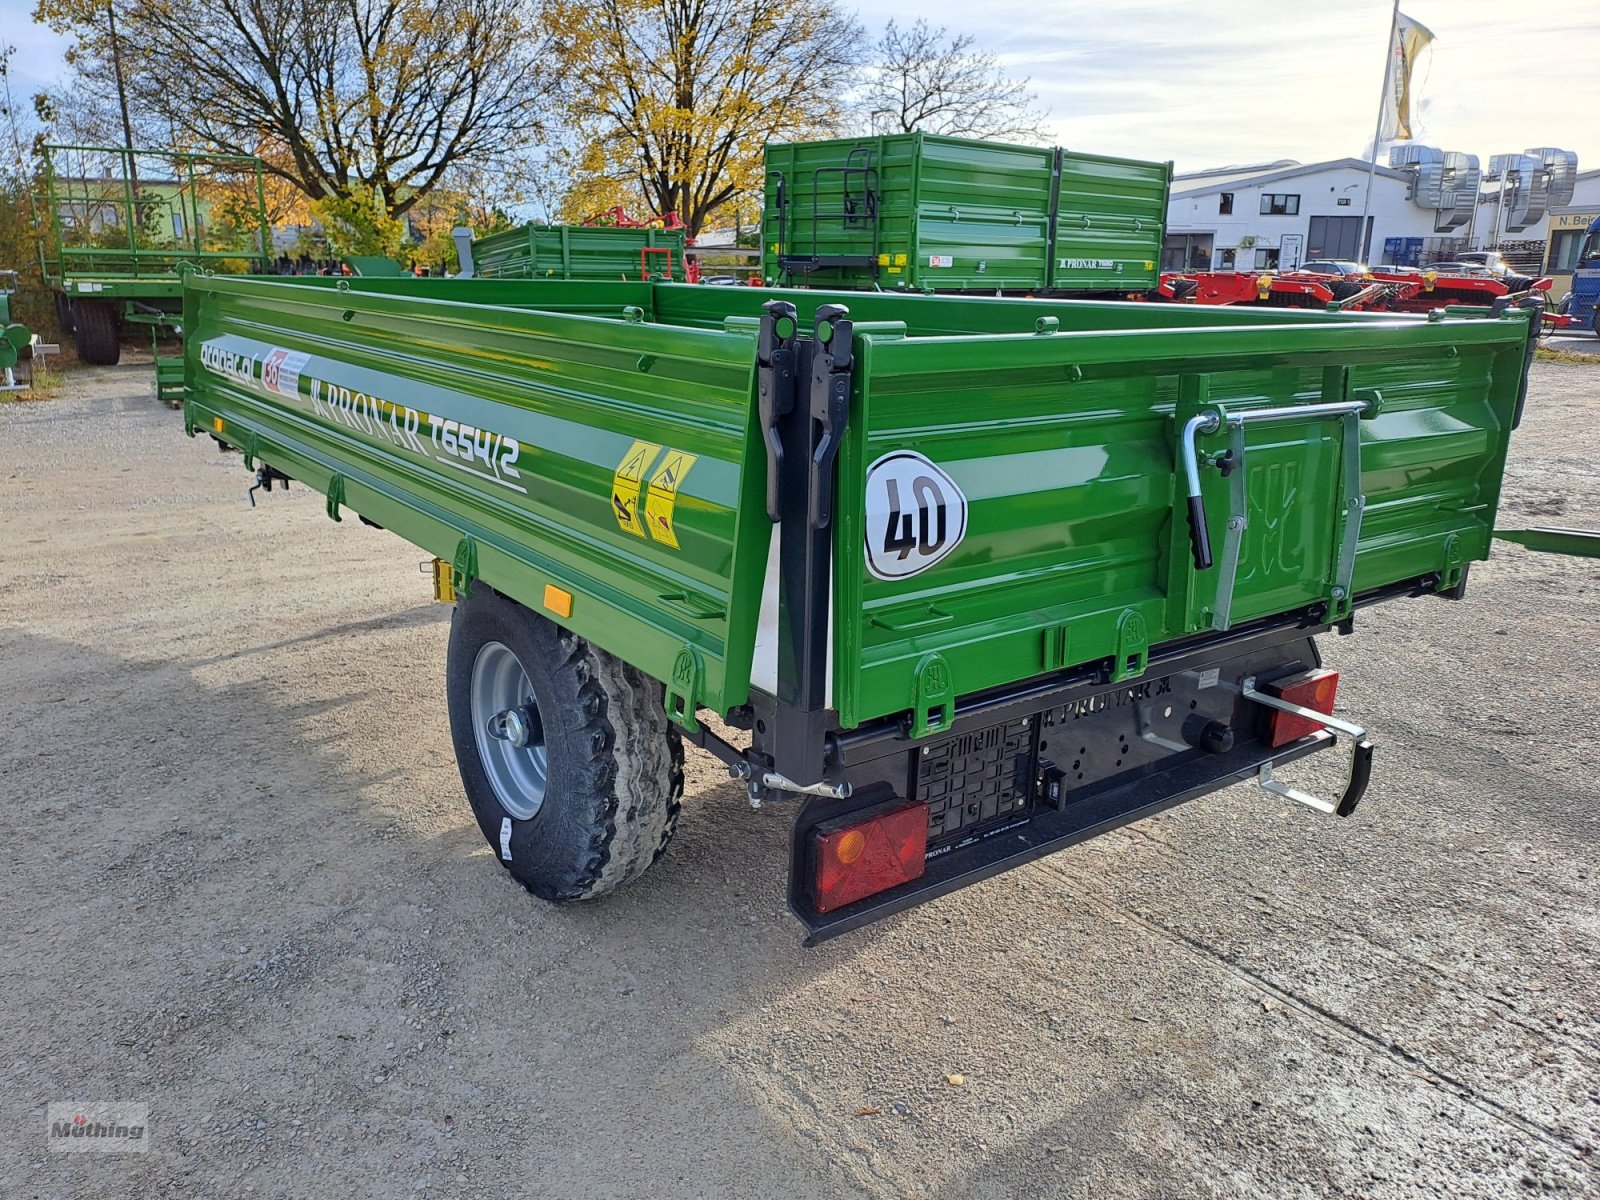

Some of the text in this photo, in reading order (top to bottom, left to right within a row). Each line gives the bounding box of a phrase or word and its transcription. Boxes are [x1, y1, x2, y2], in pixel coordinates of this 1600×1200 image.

[1559, 216, 1571, 226] N.
[1067, 260, 1097, 269] PRONAR
[327, 384, 522, 480] PRONAR T654/2
[884, 475, 947, 561] 40
[925, 845, 951, 860] PRONAR
